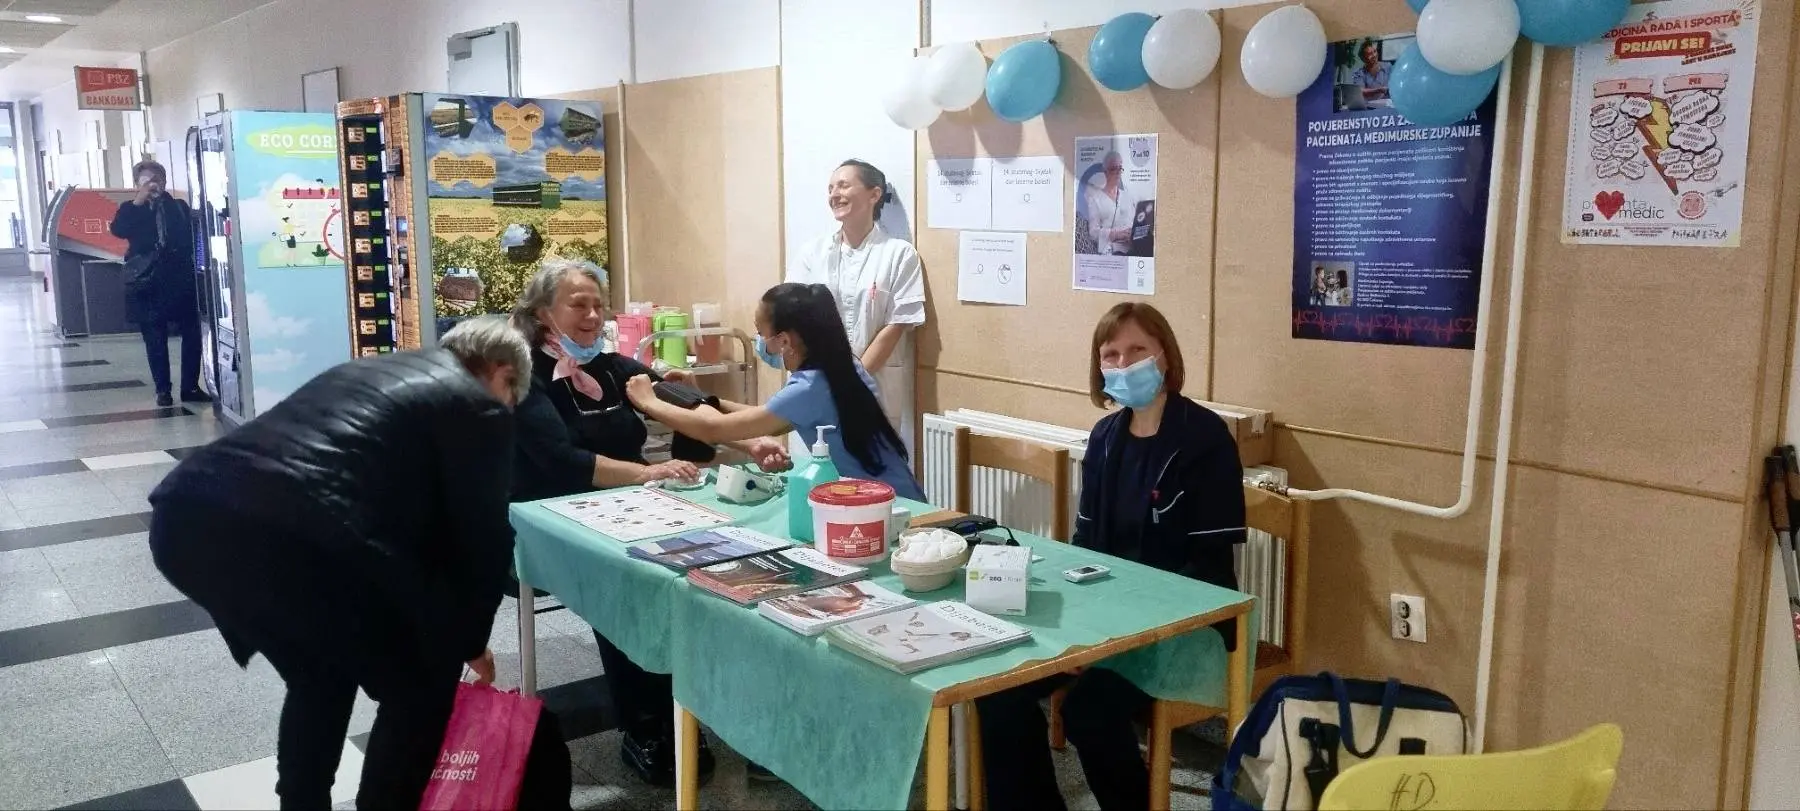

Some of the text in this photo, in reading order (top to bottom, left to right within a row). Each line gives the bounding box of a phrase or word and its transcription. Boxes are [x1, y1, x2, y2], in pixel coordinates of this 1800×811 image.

[1651, 20, 1683, 33] RADA
[1690, 13, 1738, 28] SPORTA
[1621, 38, 1678, 53] PRIJAVI
[86, 95, 135, 106] BANKOMAT
[1308, 116, 1380, 133] POVJERENSTVO
[1381, 116, 1395, 127] ZA
[260, 134, 293, 148] ECO
[299, 134, 337, 148] COR
[1306, 132, 1362, 148] PACIJENATA
[1364, 129, 1428, 145] MEĐIMURSKE
[1618, 206, 1664, 219] medic
[441, 749, 480, 767] boljih
